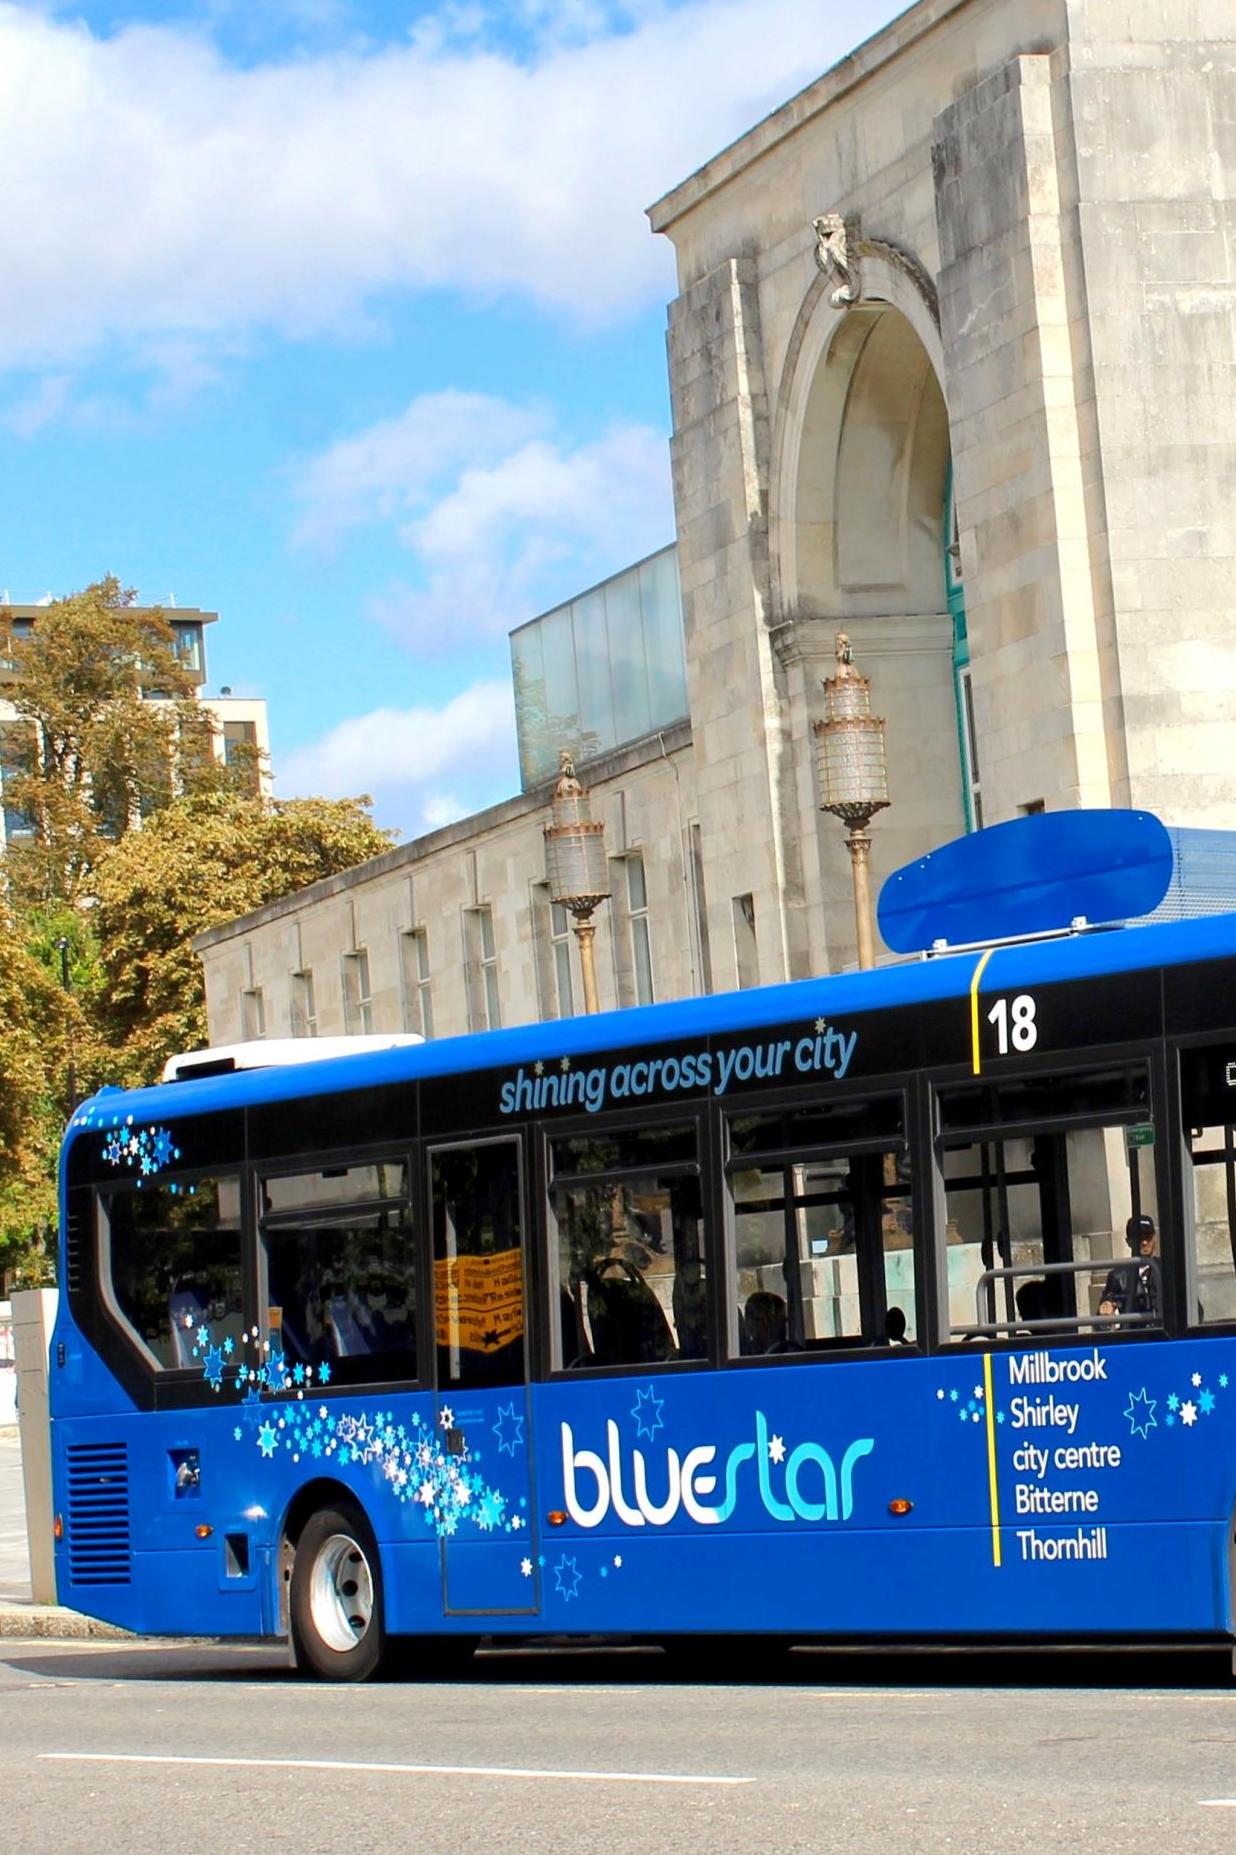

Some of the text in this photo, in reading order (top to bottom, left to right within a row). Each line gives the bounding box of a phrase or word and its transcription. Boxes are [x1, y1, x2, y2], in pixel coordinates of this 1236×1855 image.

[987, 994, 1038, 1055] 18
[500, 1016, 857, 1114] shining across your city
[1009, 1348, 1108, 1385] Millbrook
[1010, 1395, 1079, 1435] Shirley
[1012, 1441, 1121, 1479] city centre
[1015, 1484, 1099, 1514] Bitterne
[1016, 1527, 1108, 1561] Thornhill
